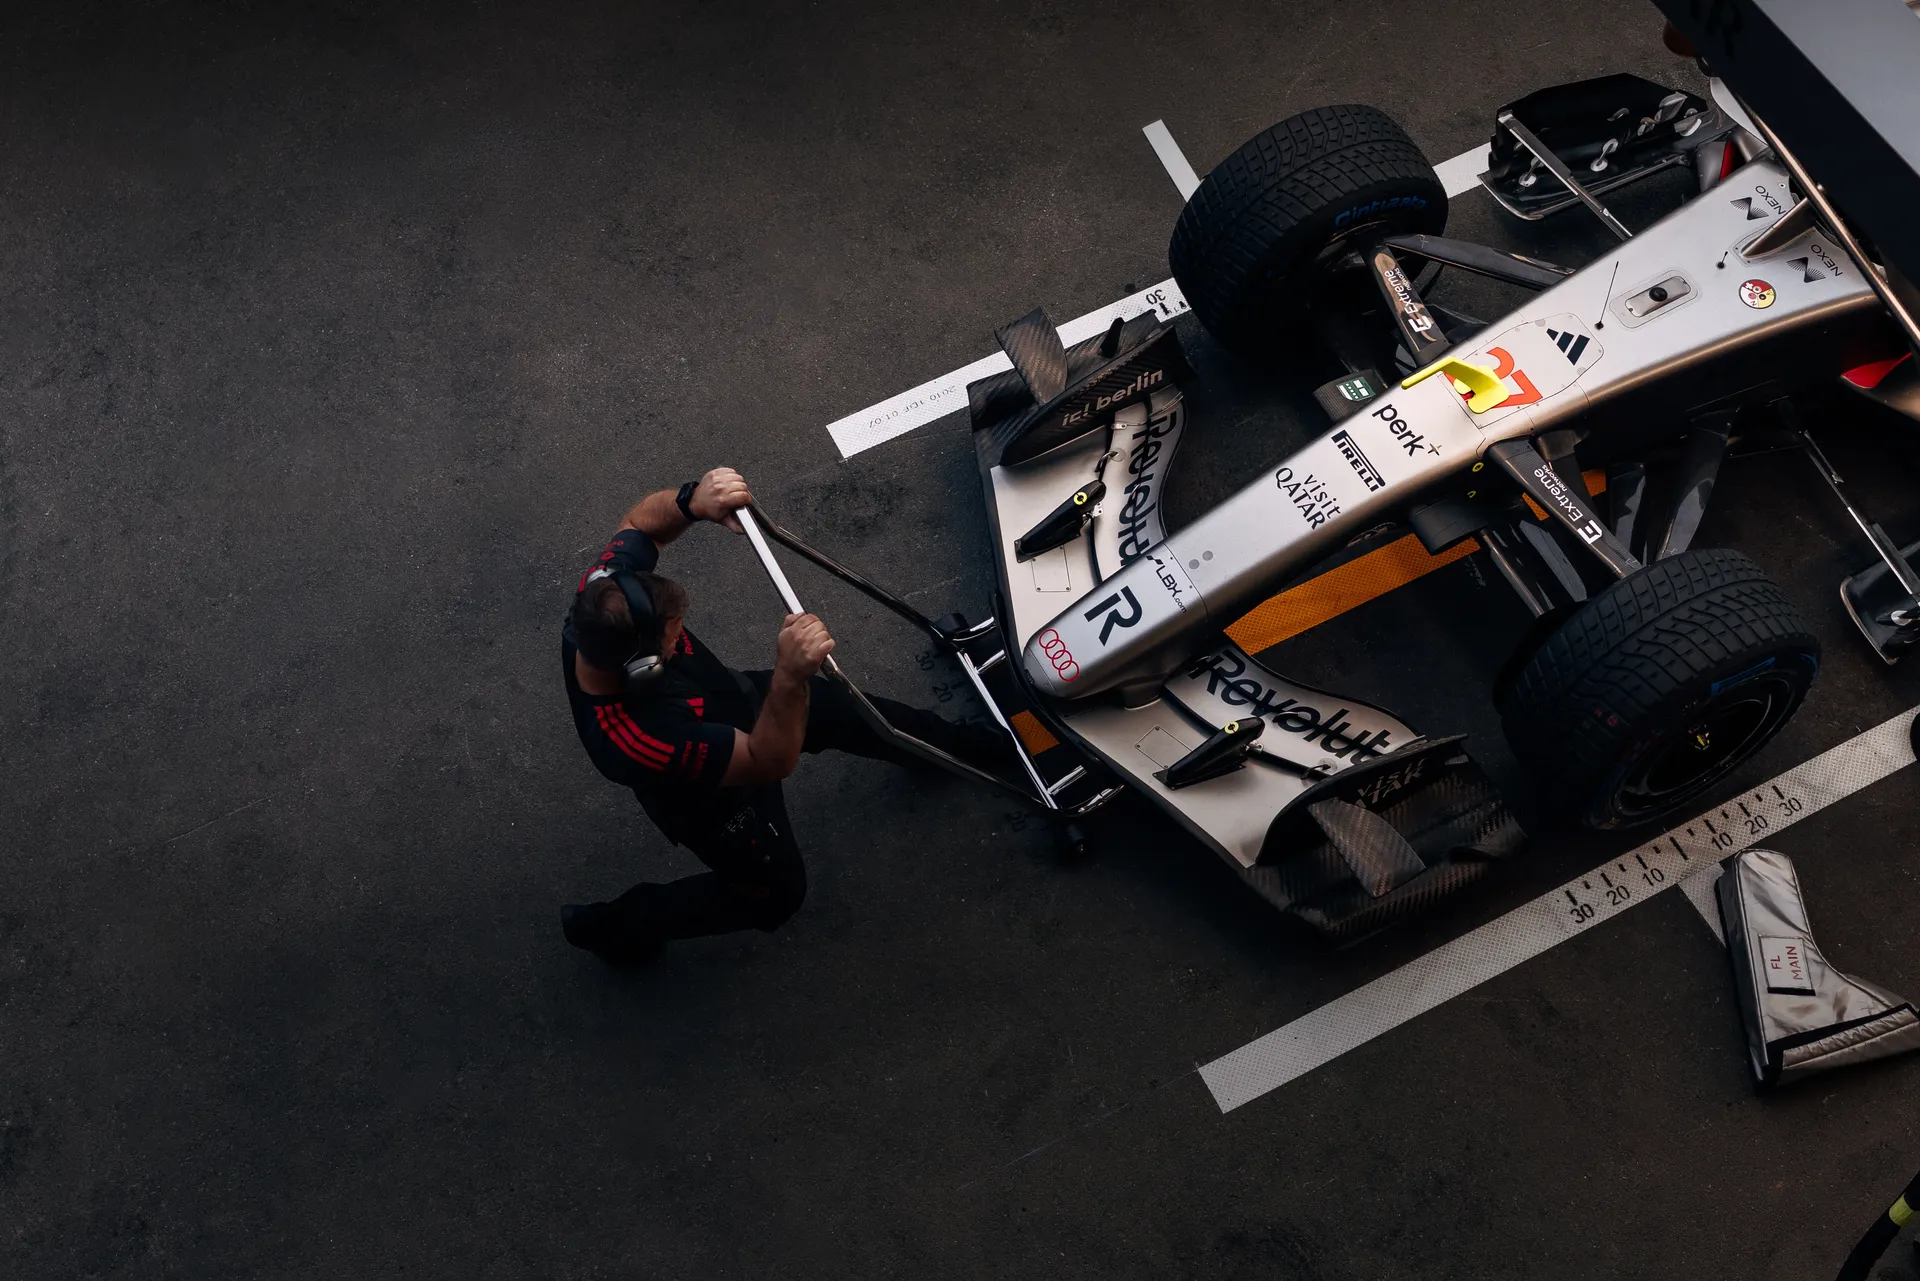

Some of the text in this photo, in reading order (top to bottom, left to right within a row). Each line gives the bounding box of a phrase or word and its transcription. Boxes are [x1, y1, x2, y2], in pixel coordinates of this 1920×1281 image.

[1755, 185, 1786, 215] NEXO
[1810, 244, 1843, 277] NEXO
[1145, 289, 1166, 305] 30
[1384, 269, 1419, 314] Extreme
[1062, 368, 1163, 427] ic! berlin
[1331, 429, 1386, 492] PIRELLI
[1541, 464, 1567, 492] networks
[1118, 409, 1178, 567] Revolu
[1275, 467, 1326, 530] QATAR
[1304, 474, 1341, 519] visit
[1534, 468, 1583, 522] Extreme
[1084, 585, 1142, 646] R
[1187, 650, 1391, 767] Revolut
[1570, 797, 1801, 924] 30 20 10 10 20 30
[1770, 955, 1782, 970] FL
[1785, 945, 1804, 980] MAIN
